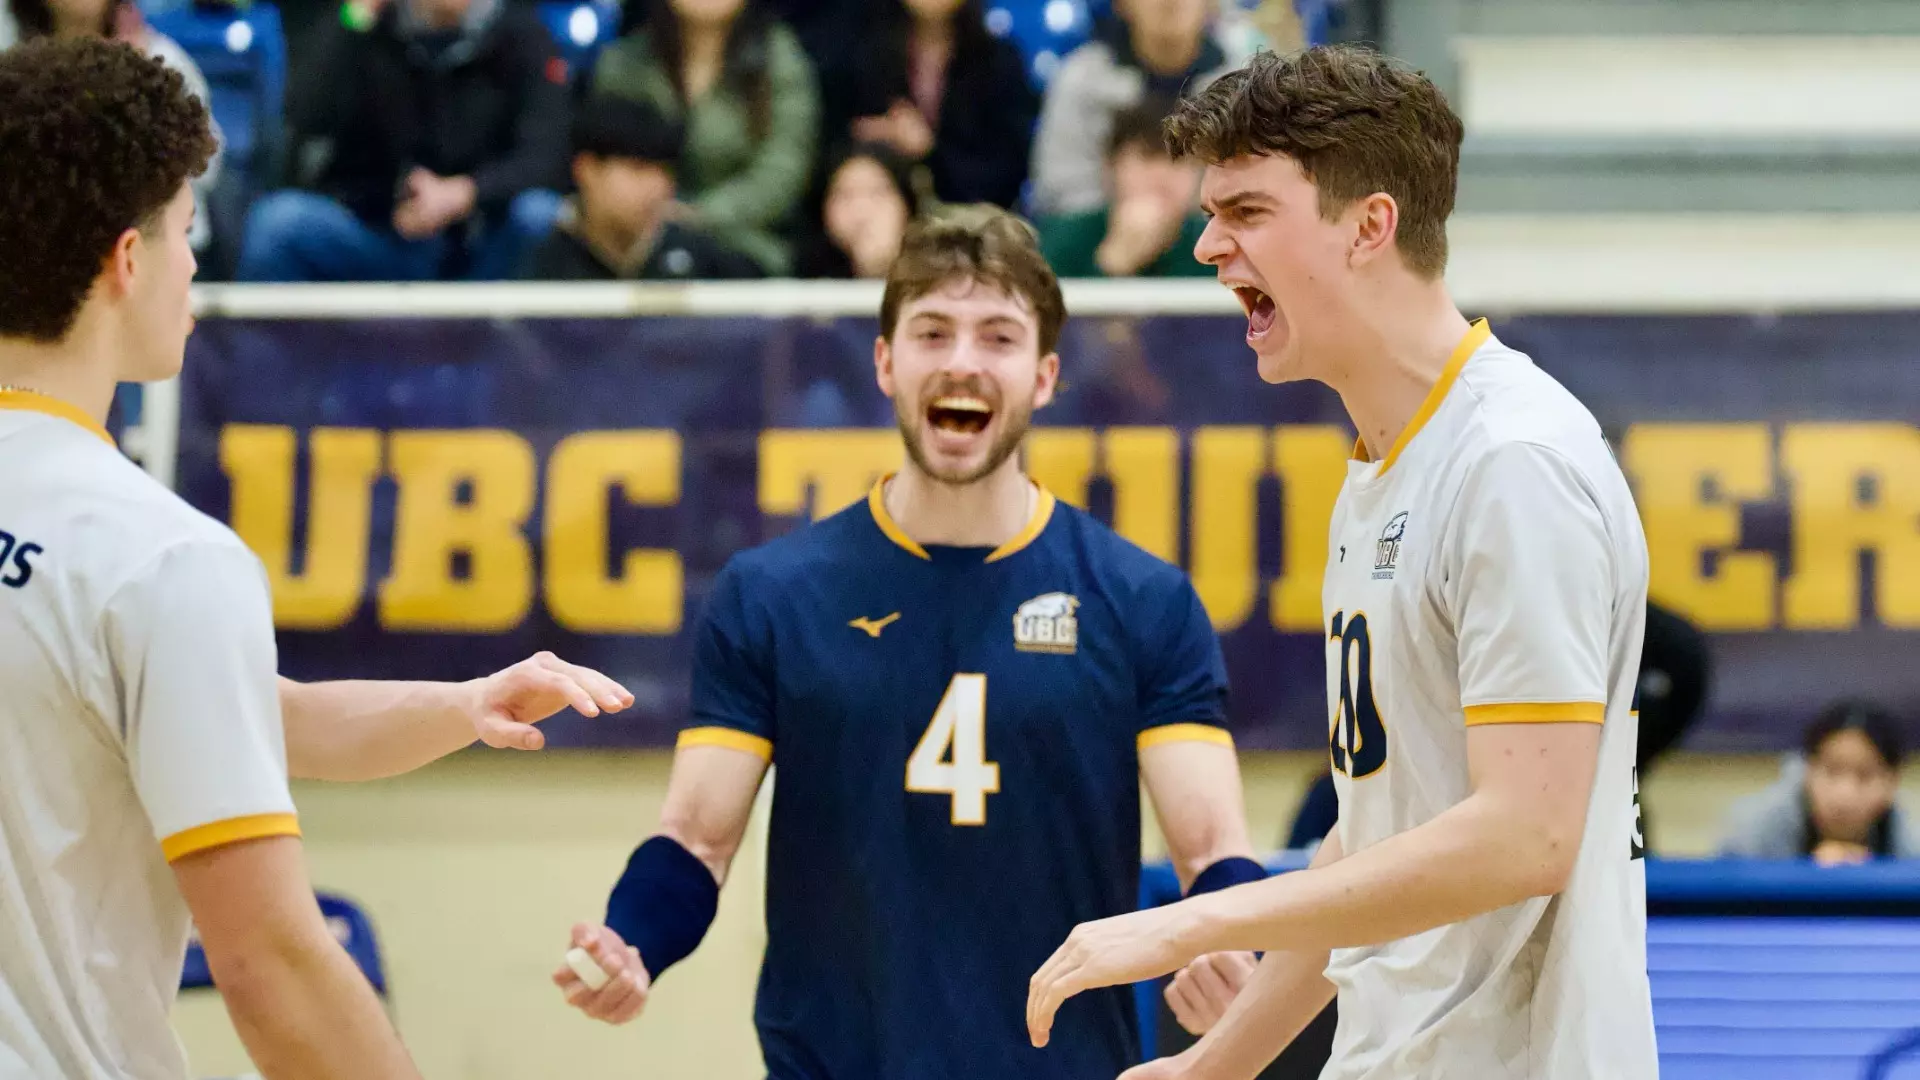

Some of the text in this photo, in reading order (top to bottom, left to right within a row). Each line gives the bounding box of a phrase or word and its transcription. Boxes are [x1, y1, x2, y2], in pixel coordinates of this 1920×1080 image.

[220, 424, 683, 635] UBC
[1013, 612, 1078, 644] UBC
[904, 672, 1000, 827] 4
